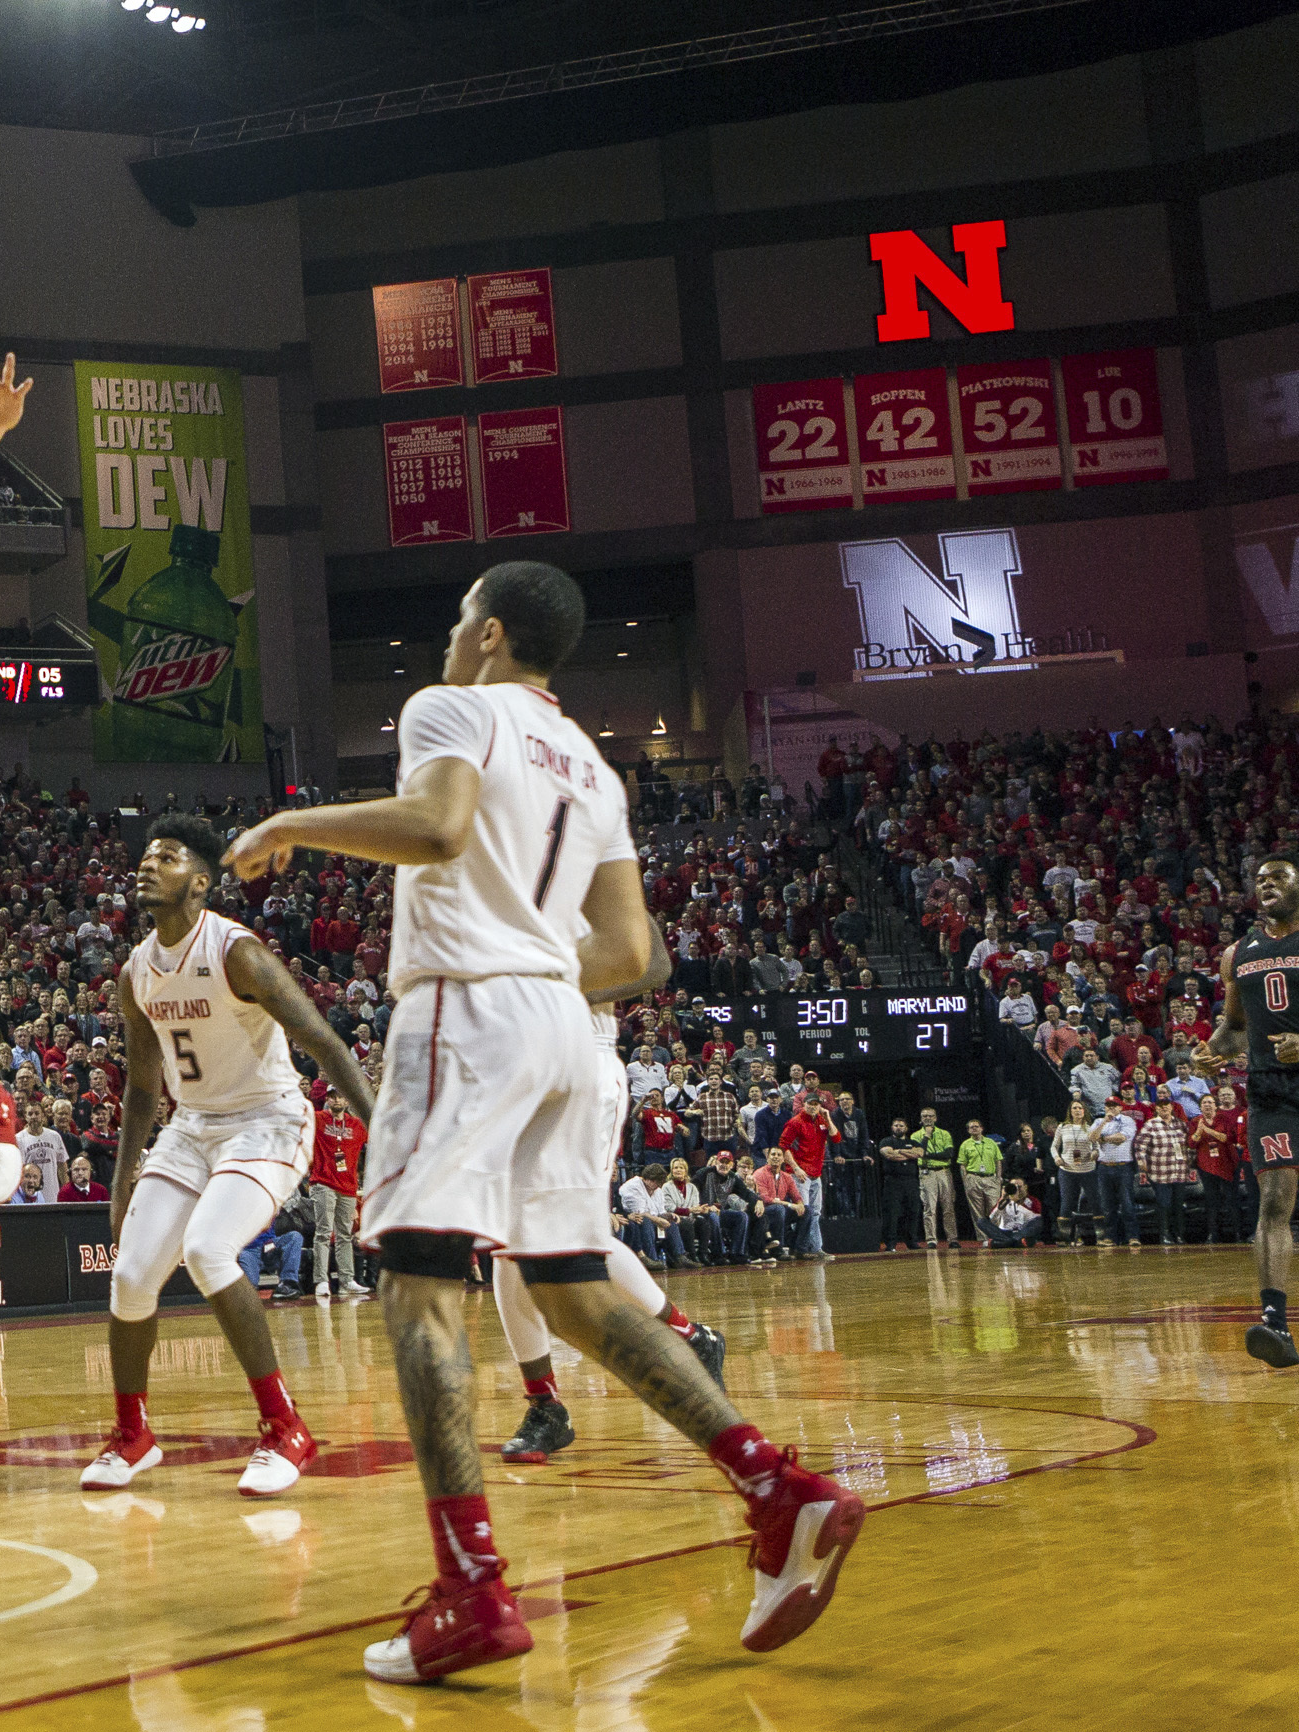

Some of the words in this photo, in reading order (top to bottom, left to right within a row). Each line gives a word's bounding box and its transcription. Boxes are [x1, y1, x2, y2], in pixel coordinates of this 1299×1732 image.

[869, 219, 1015, 343] N
[420, 315, 452, 329] 1991
[421, 326, 454, 340] 1993
[385, 354, 415, 366] 2014
[508, 359, 524, 374] N
[413, 369, 429, 384] N
[960, 376, 1050, 397] PIATKOWSKI
[91, 376, 225, 416] NEBRASKA
[870, 388, 927, 406] HOPPEN
[777, 399, 825, 416] LANTZ
[1082, 386, 1144, 434] 10
[865, 406, 939, 453] 42
[972, 396, 1046, 443] 52
[92, 414, 174, 450] LOVES
[428, 430, 462, 440] SEASON
[766, 415, 840, 463] 22
[390, 443, 461, 457] CHAMPIONSHIPS
[488, 449, 520, 463] 1994
[1077, 448, 1101, 468] N
[392, 458, 424, 472] 1912
[429, 455, 462, 469] 1913
[970, 458, 993, 479] N
[392, 470, 425, 483] 1914
[430, 466, 462, 479] 1916
[865, 468, 888, 488] N
[891, 467, 947, 481] 1983-1986
[95, 452, 229, 533] DEW
[393, 481, 425, 494] 1937
[431, 478, 463, 491] 1949
[764, 477, 787, 497] N
[394, 492, 426, 506] 1950
[421, 519, 440, 537] N
[517, 510, 536, 528] N
[860, 641, 967, 674] Bryan
[38, 667, 62, 684] 05
[41, 686, 65, 699] FLS
[533, 794, 574, 913] 1
[1263, 971, 1289, 1012] 0
[797, 998, 849, 1027] 3:50
[887, 996, 968, 1016] MARYLAND
[761, 1031, 777, 1041] TOL
[799, 1029, 833, 1040] PERIOD
[854, 1027, 871, 1038] TOL
[915, 1023, 950, 1051] 27
[169, 1028, 202, 1082] 5
[816, 1042, 824, 1056] 1
[857, 1040, 869, 1053] 4
[653, 1114, 674, 1135] N
[1260, 1131, 1293, 1162] N
